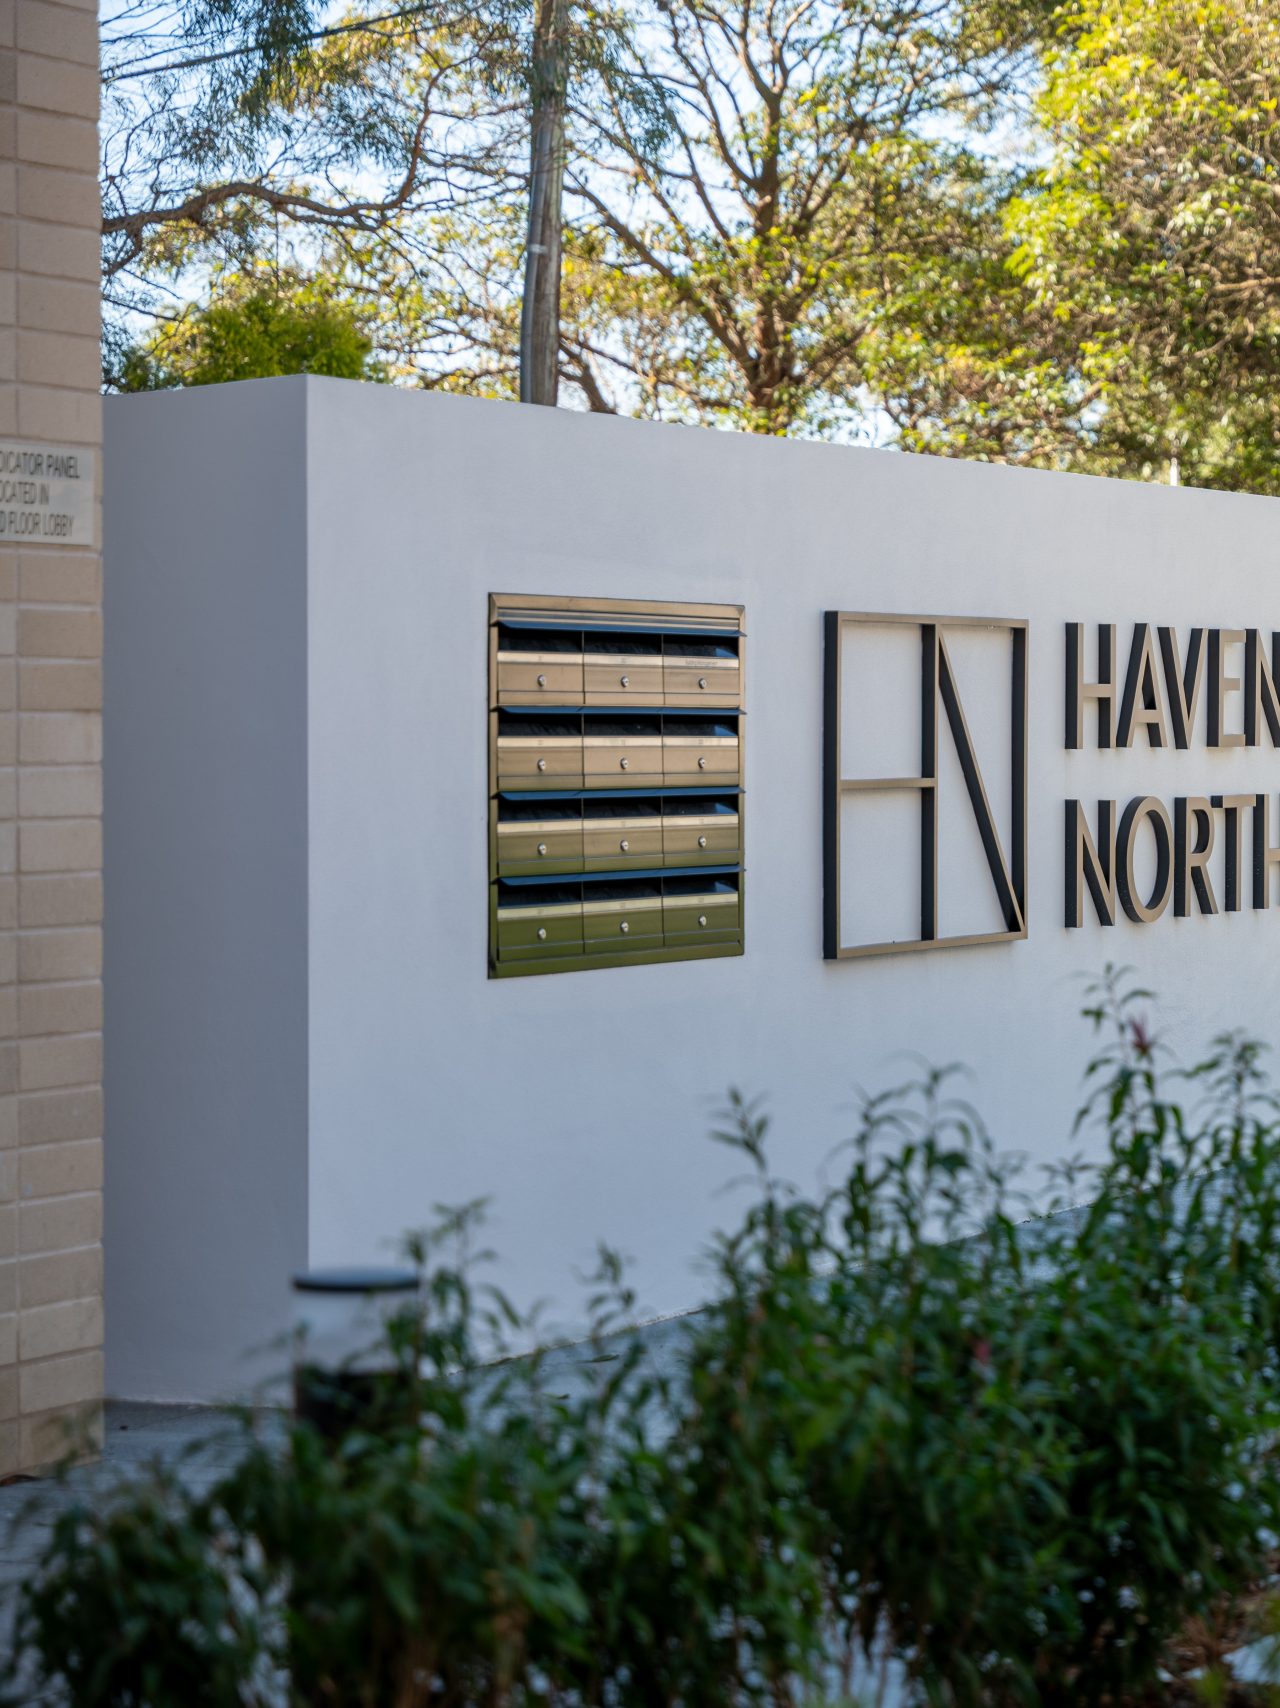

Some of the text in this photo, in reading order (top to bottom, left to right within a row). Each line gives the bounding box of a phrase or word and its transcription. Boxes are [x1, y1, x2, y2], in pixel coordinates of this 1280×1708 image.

[46, 454, 80, 479] PANEL
[40, 483, 50, 505] IN
[8, 511, 42, 536] FLOOR
[43, 513, 75, 537] LOBBY
